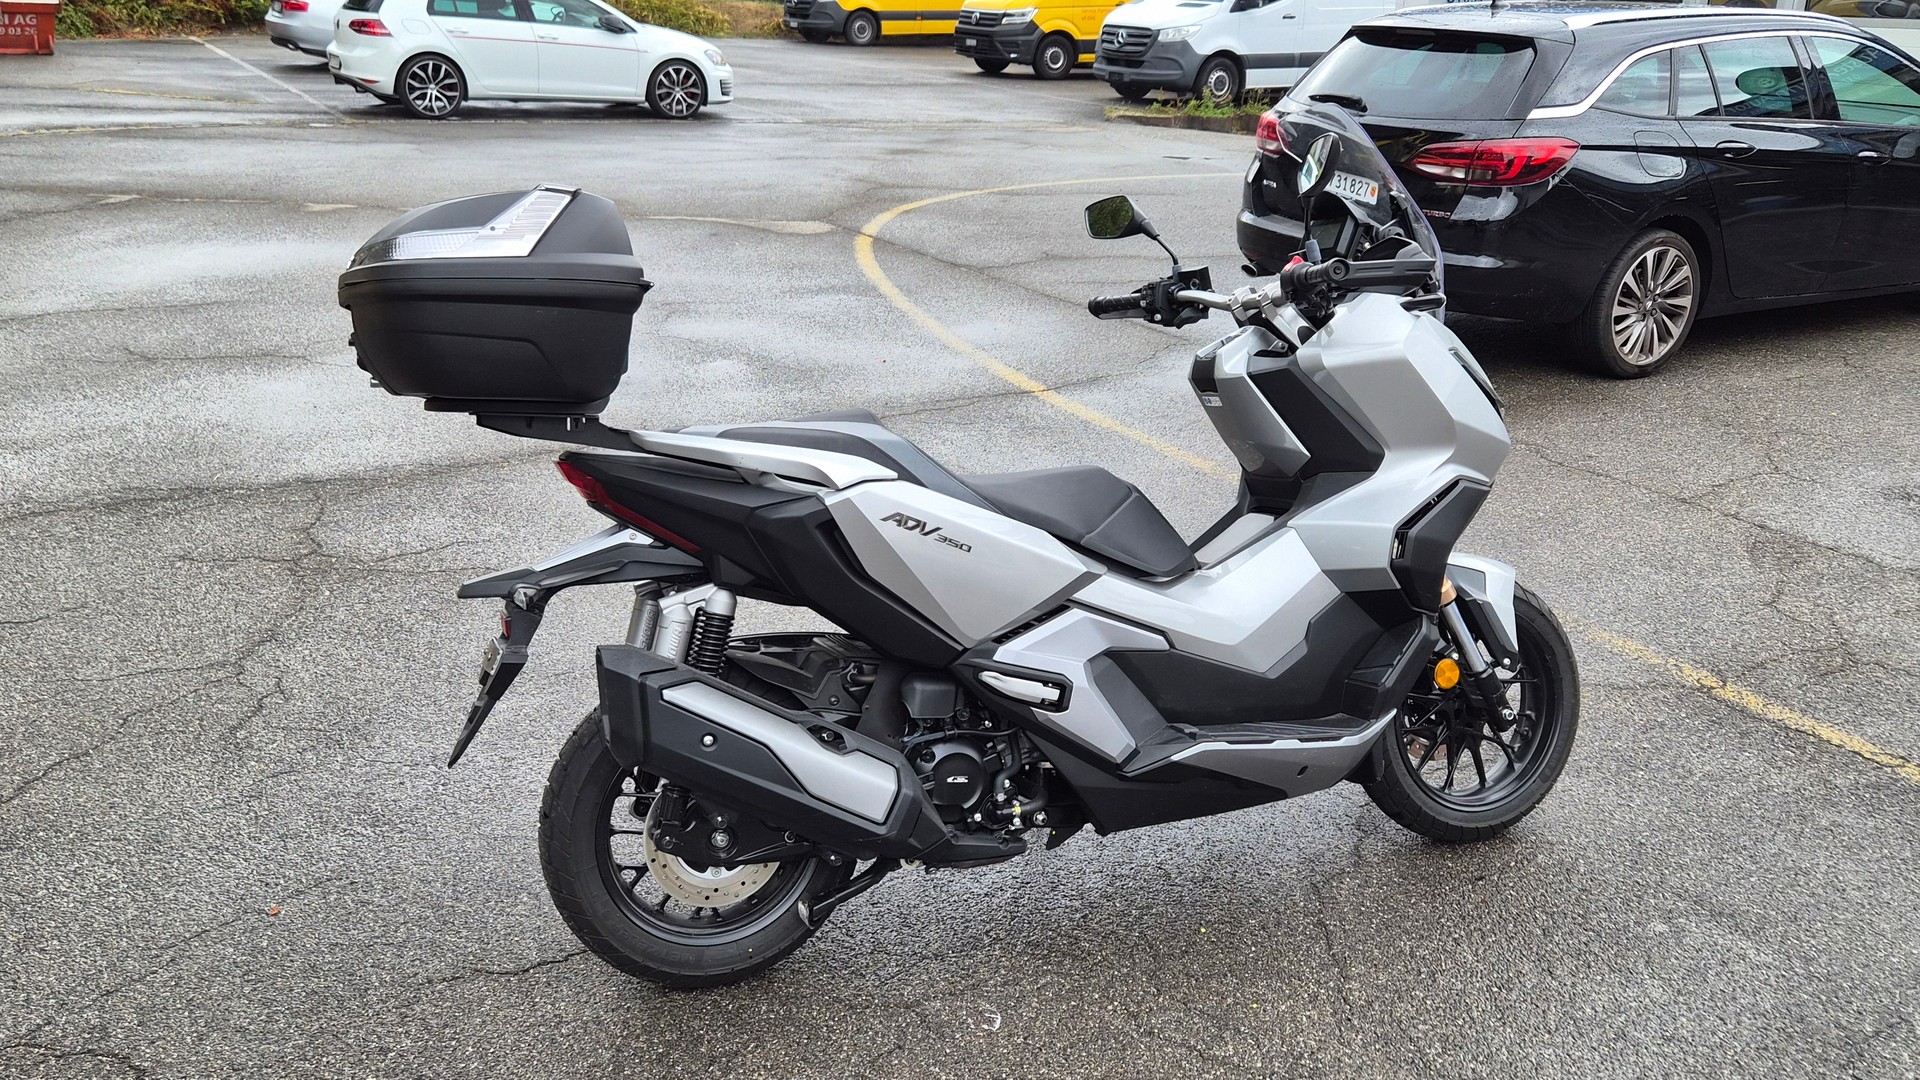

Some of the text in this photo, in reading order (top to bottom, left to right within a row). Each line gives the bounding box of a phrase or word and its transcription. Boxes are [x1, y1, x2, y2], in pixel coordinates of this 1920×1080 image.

[14, 14, 37, 25] AG
[1422, 209, 1451, 219] TURBO
[880, 512, 972, 553] ADV 350
